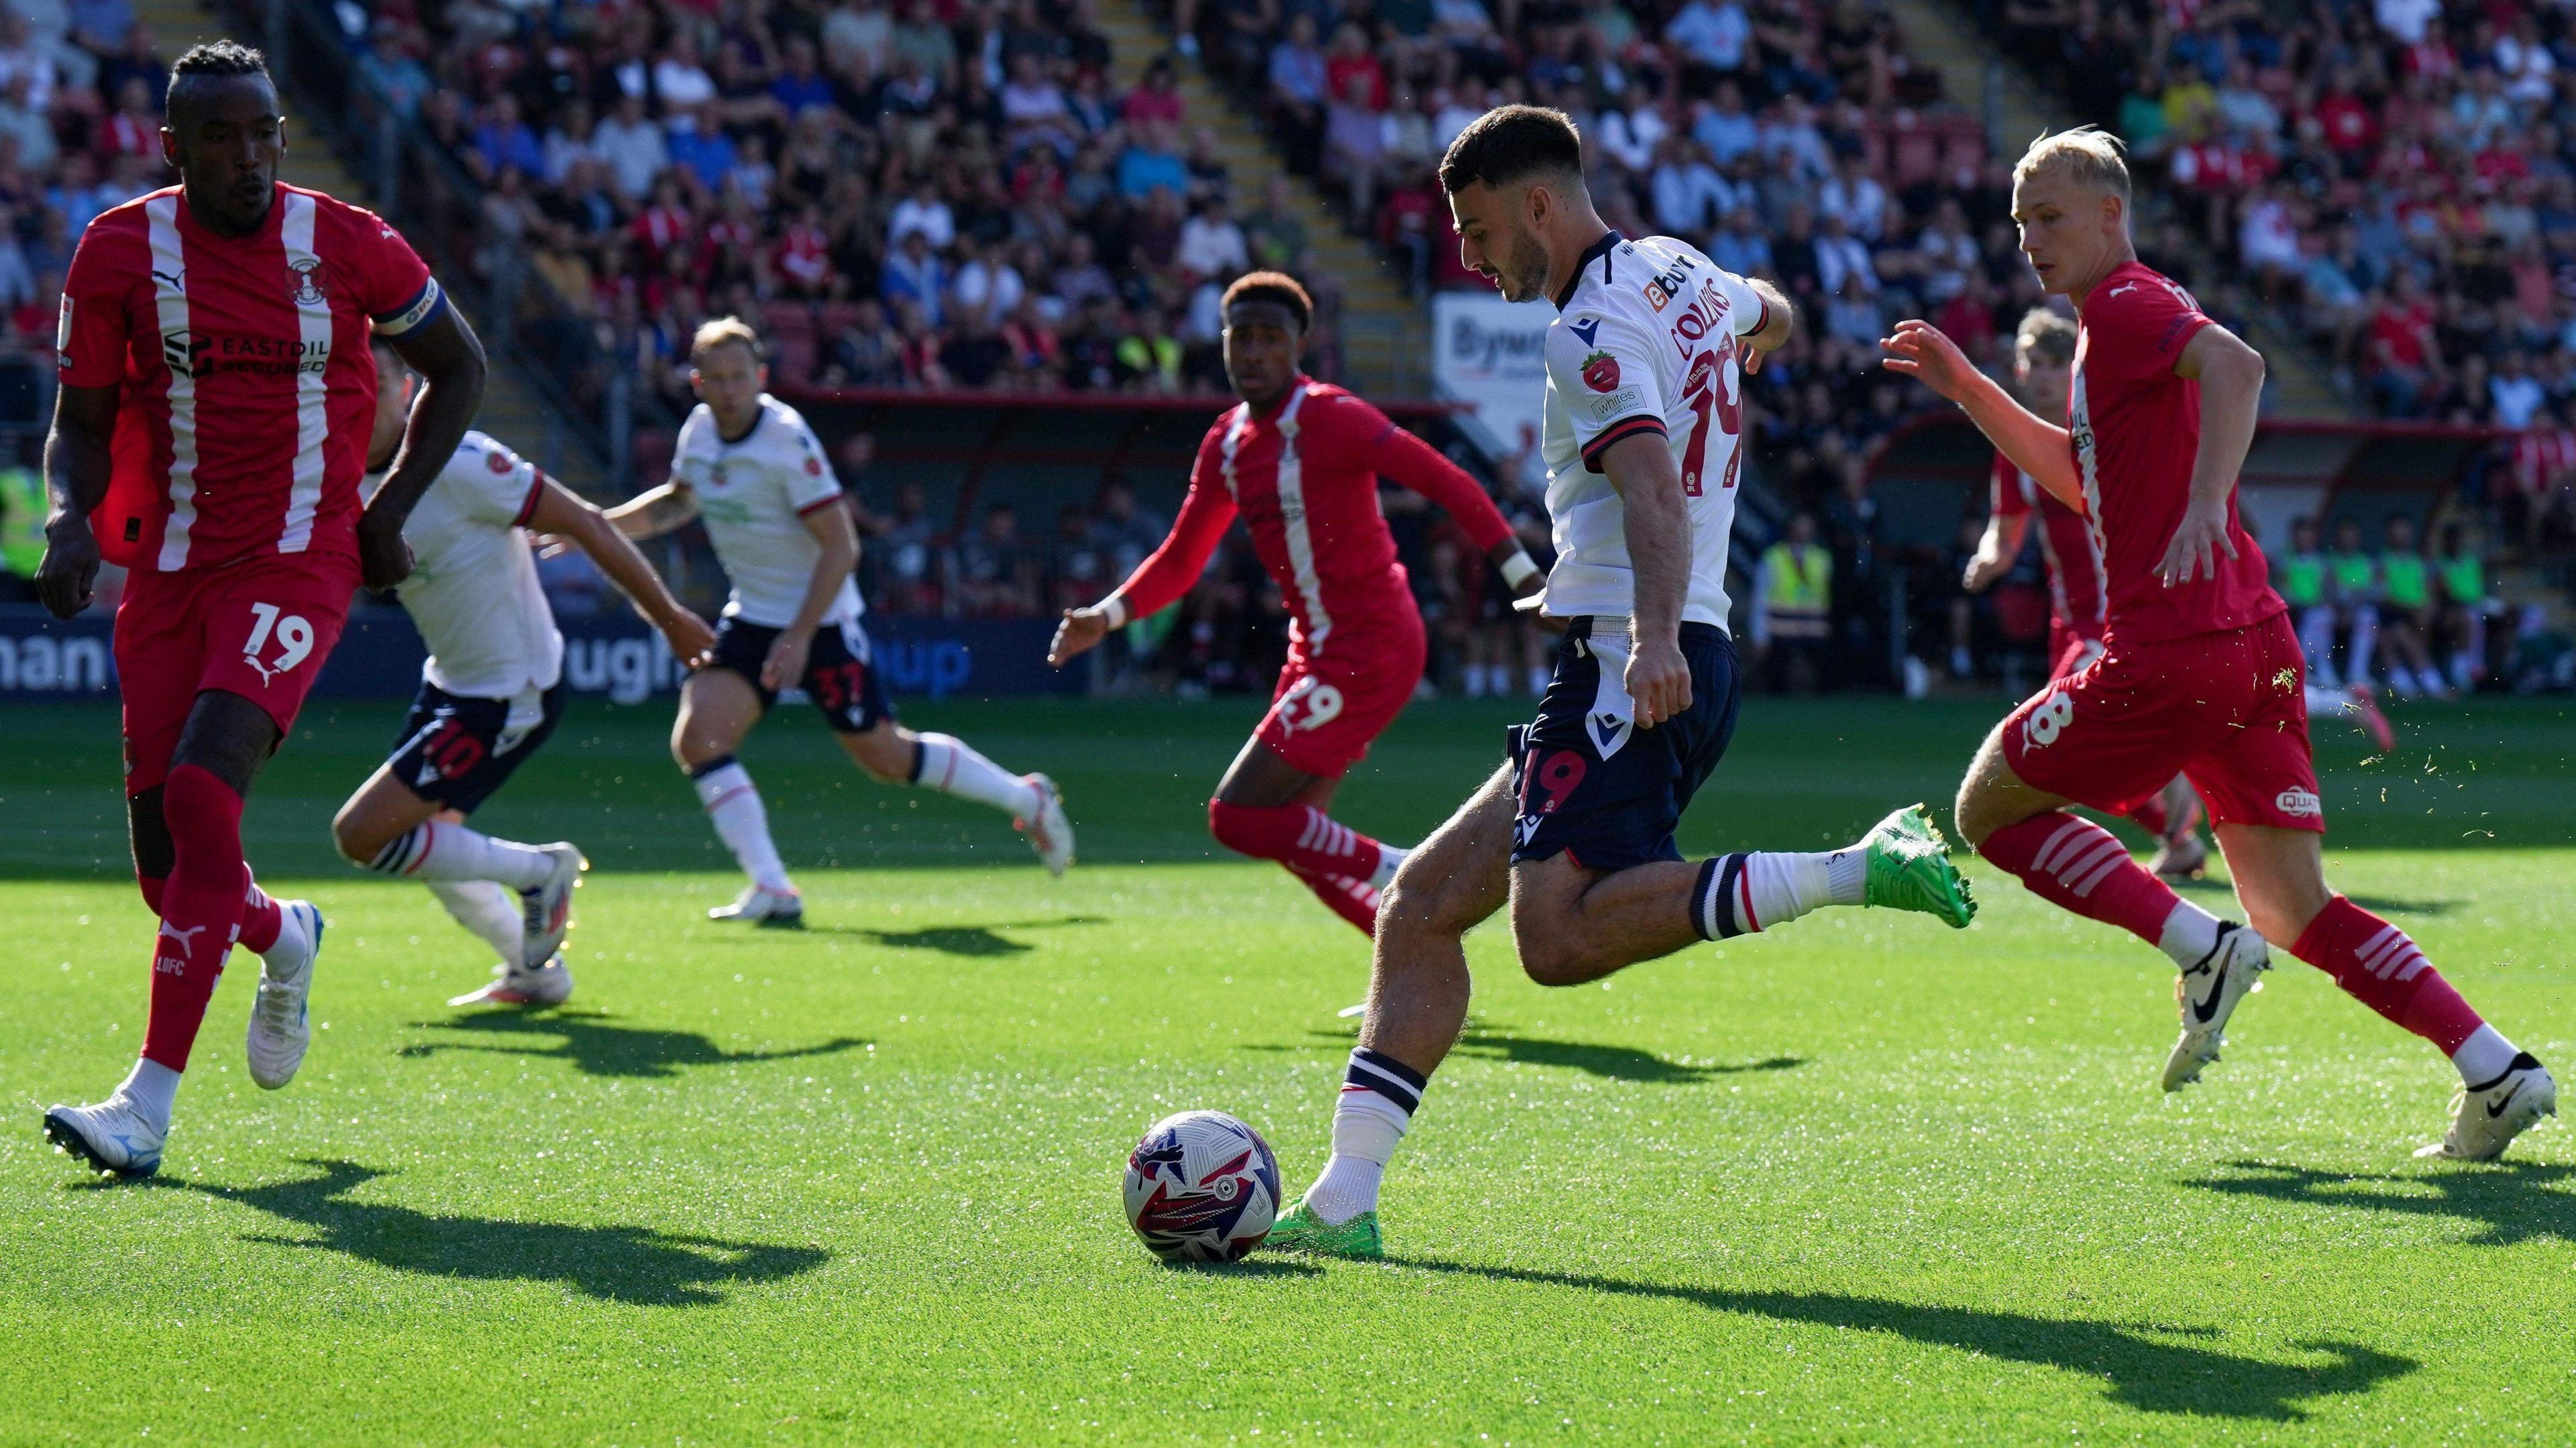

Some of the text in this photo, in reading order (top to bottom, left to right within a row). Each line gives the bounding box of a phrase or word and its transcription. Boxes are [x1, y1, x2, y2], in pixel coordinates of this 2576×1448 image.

[223, 338, 329, 357] EASTDIL
[1670, 278, 1730, 361] COLLINS
[1598, 391, 1635, 414] whites
[1680, 331, 1743, 497] 19
[242, 602, 315, 672] 19
[1277, 675, 1344, 732] 29
[2029, 690, 2074, 746] 8
[422, 718, 486, 780] 10
[1518, 747, 1587, 814] 19
[156, 955, 185, 977] LOFC
